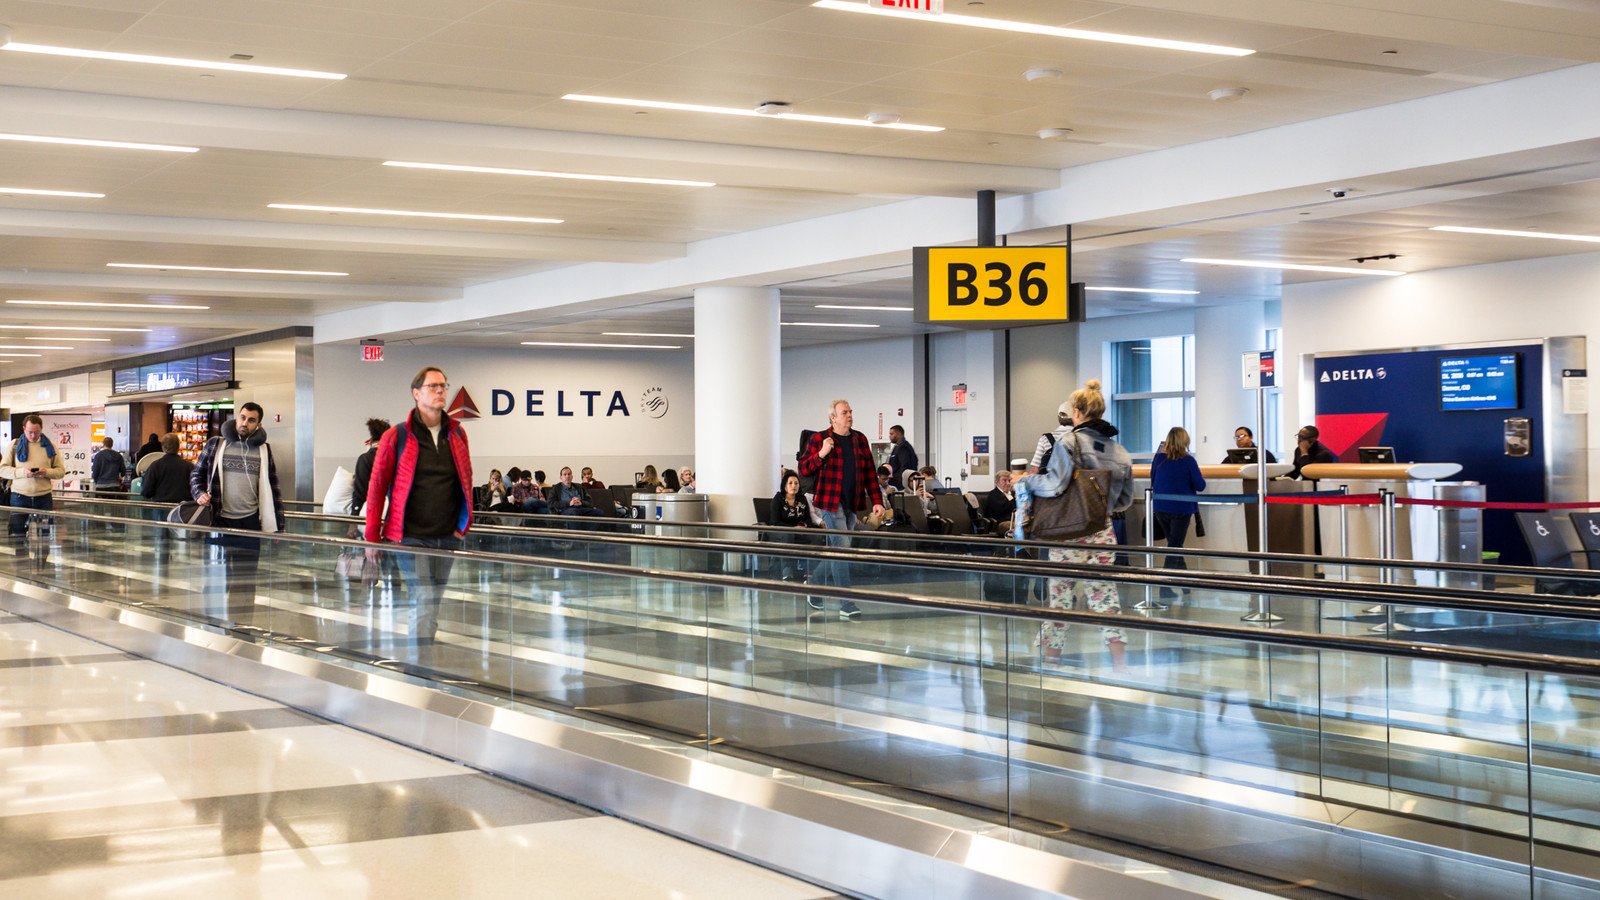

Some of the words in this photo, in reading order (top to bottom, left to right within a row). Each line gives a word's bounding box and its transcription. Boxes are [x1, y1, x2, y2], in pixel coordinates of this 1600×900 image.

[947, 261, 1049, 306] B36
[364, 346, 382, 360] EXIT
[1332, 368, 1374, 381] DELTA
[491, 388, 630, 417] DELTA
[74, 452, 86, 460] 40
